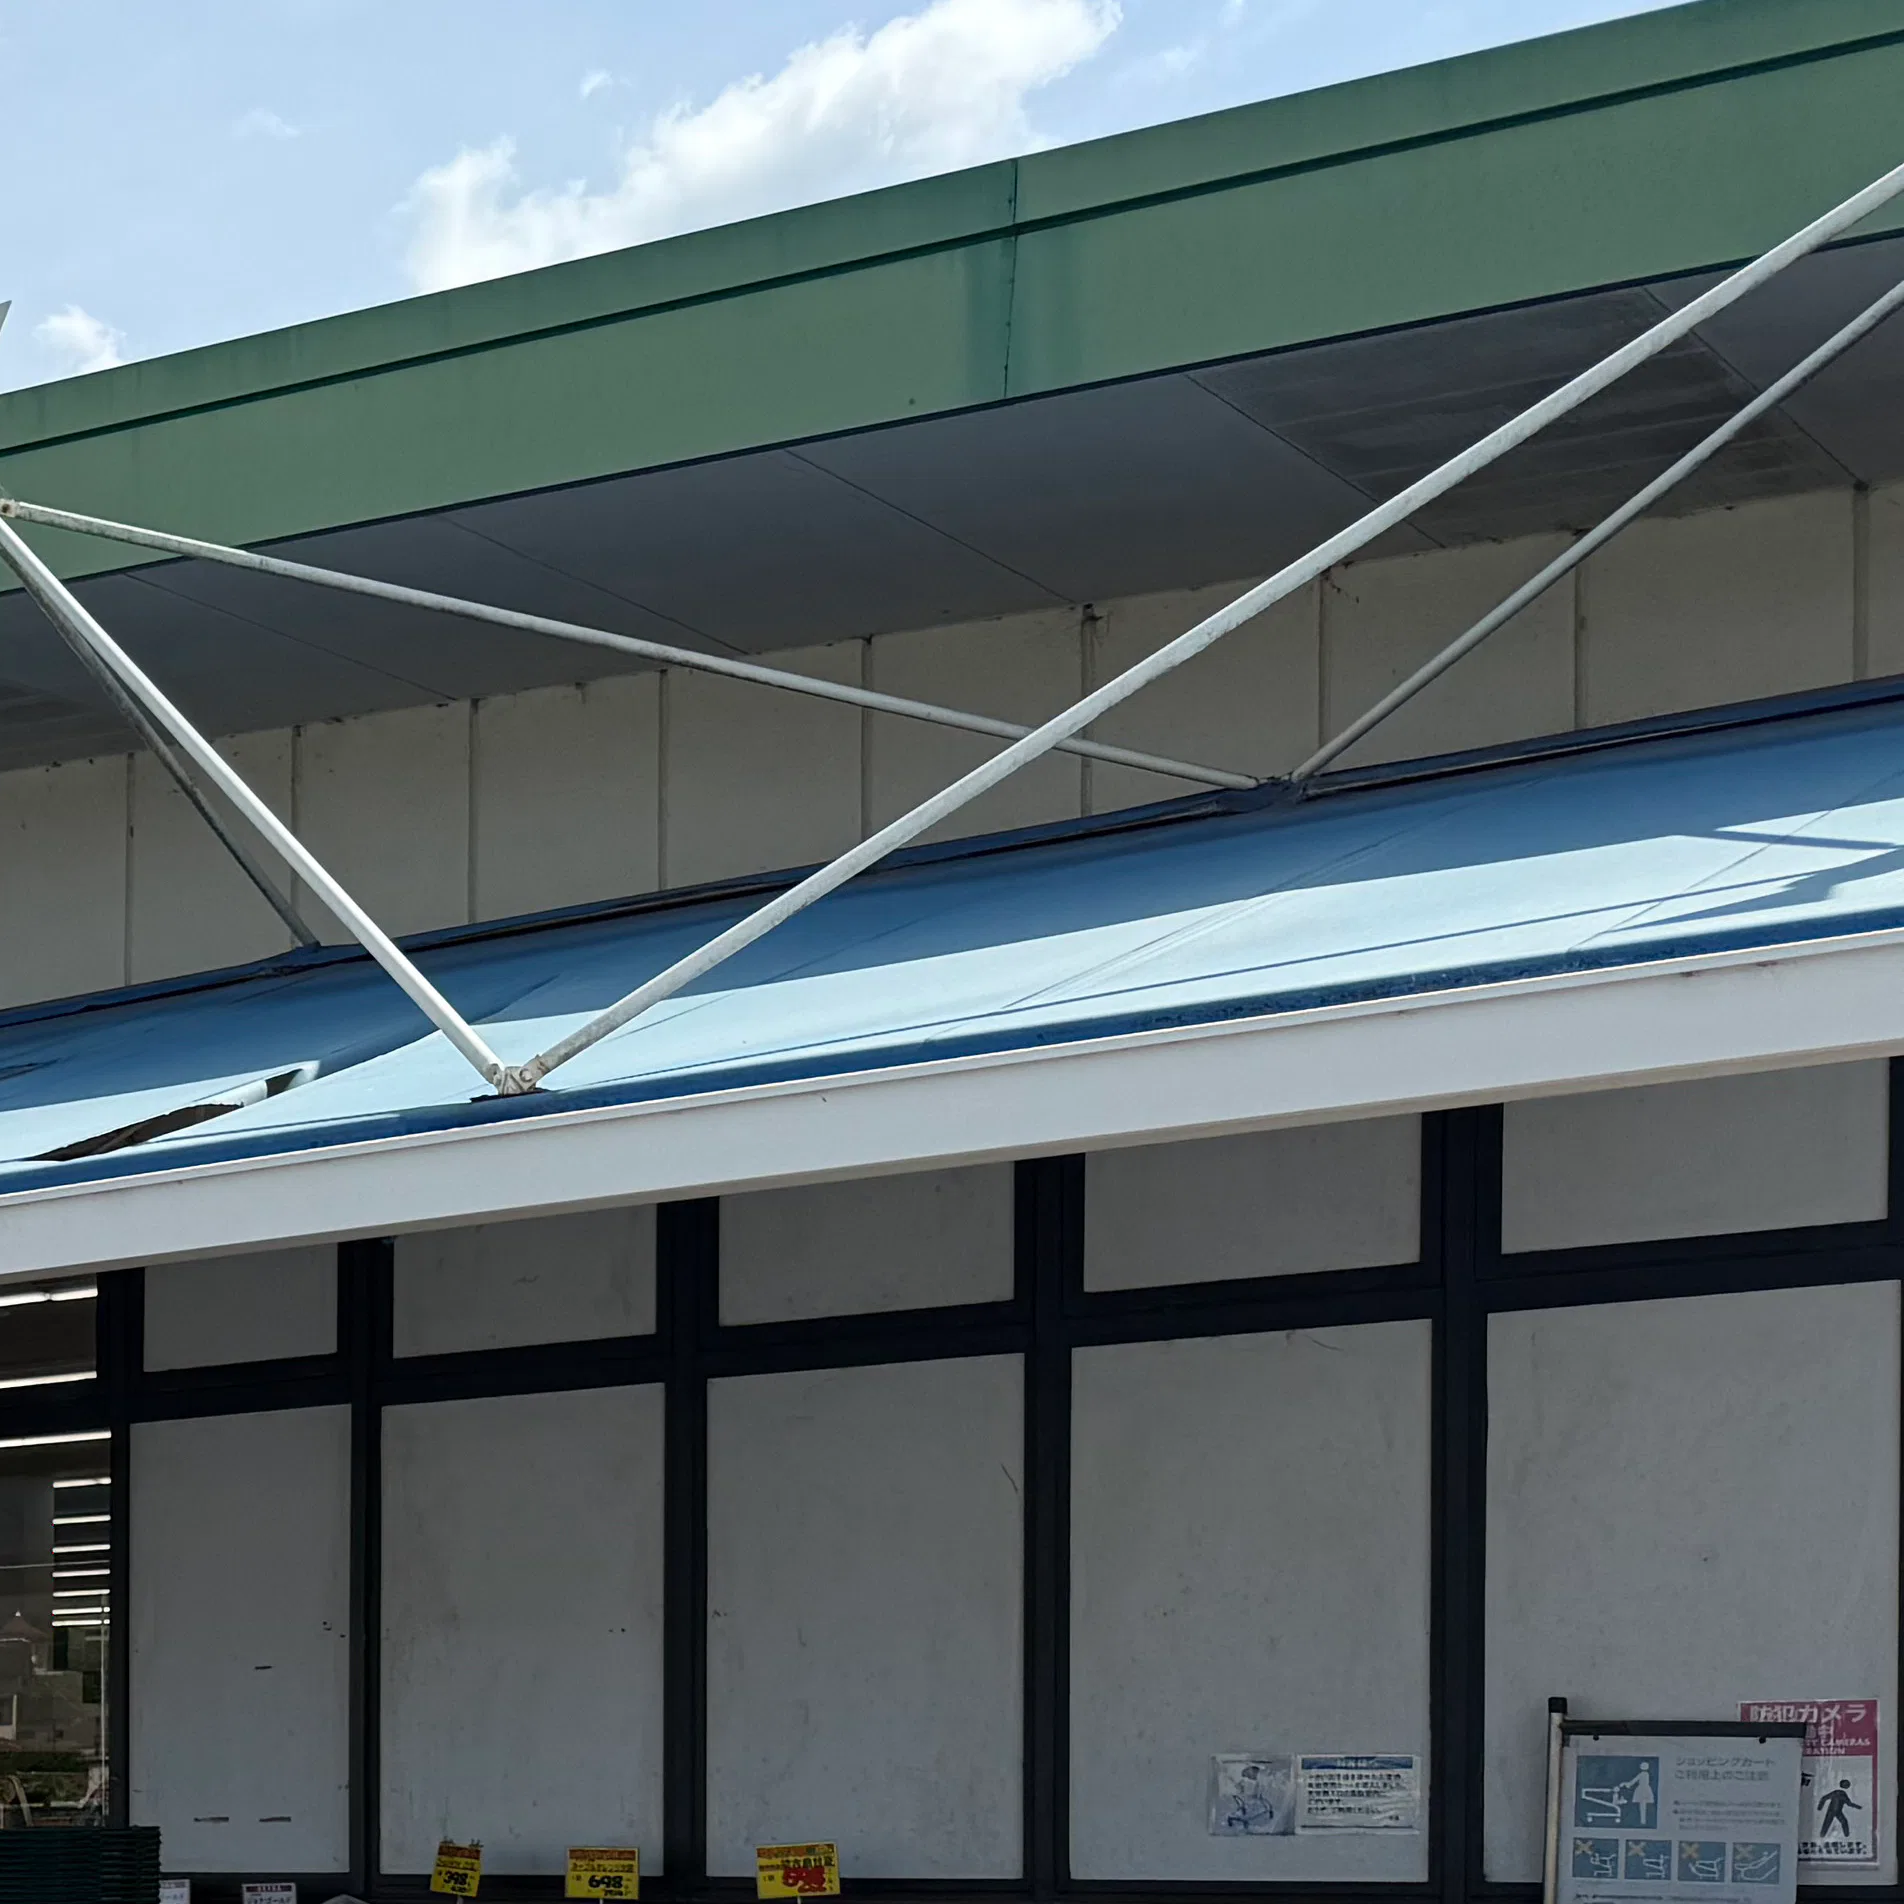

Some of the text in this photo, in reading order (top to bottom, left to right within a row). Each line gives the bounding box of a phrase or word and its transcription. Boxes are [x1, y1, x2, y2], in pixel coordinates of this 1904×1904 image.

[1749, 1703, 1868, 1723] 防犯カメラ
[1675, 1755, 1777, 1767] ショッピングカート
[588, 1874, 624, 1888] 698
